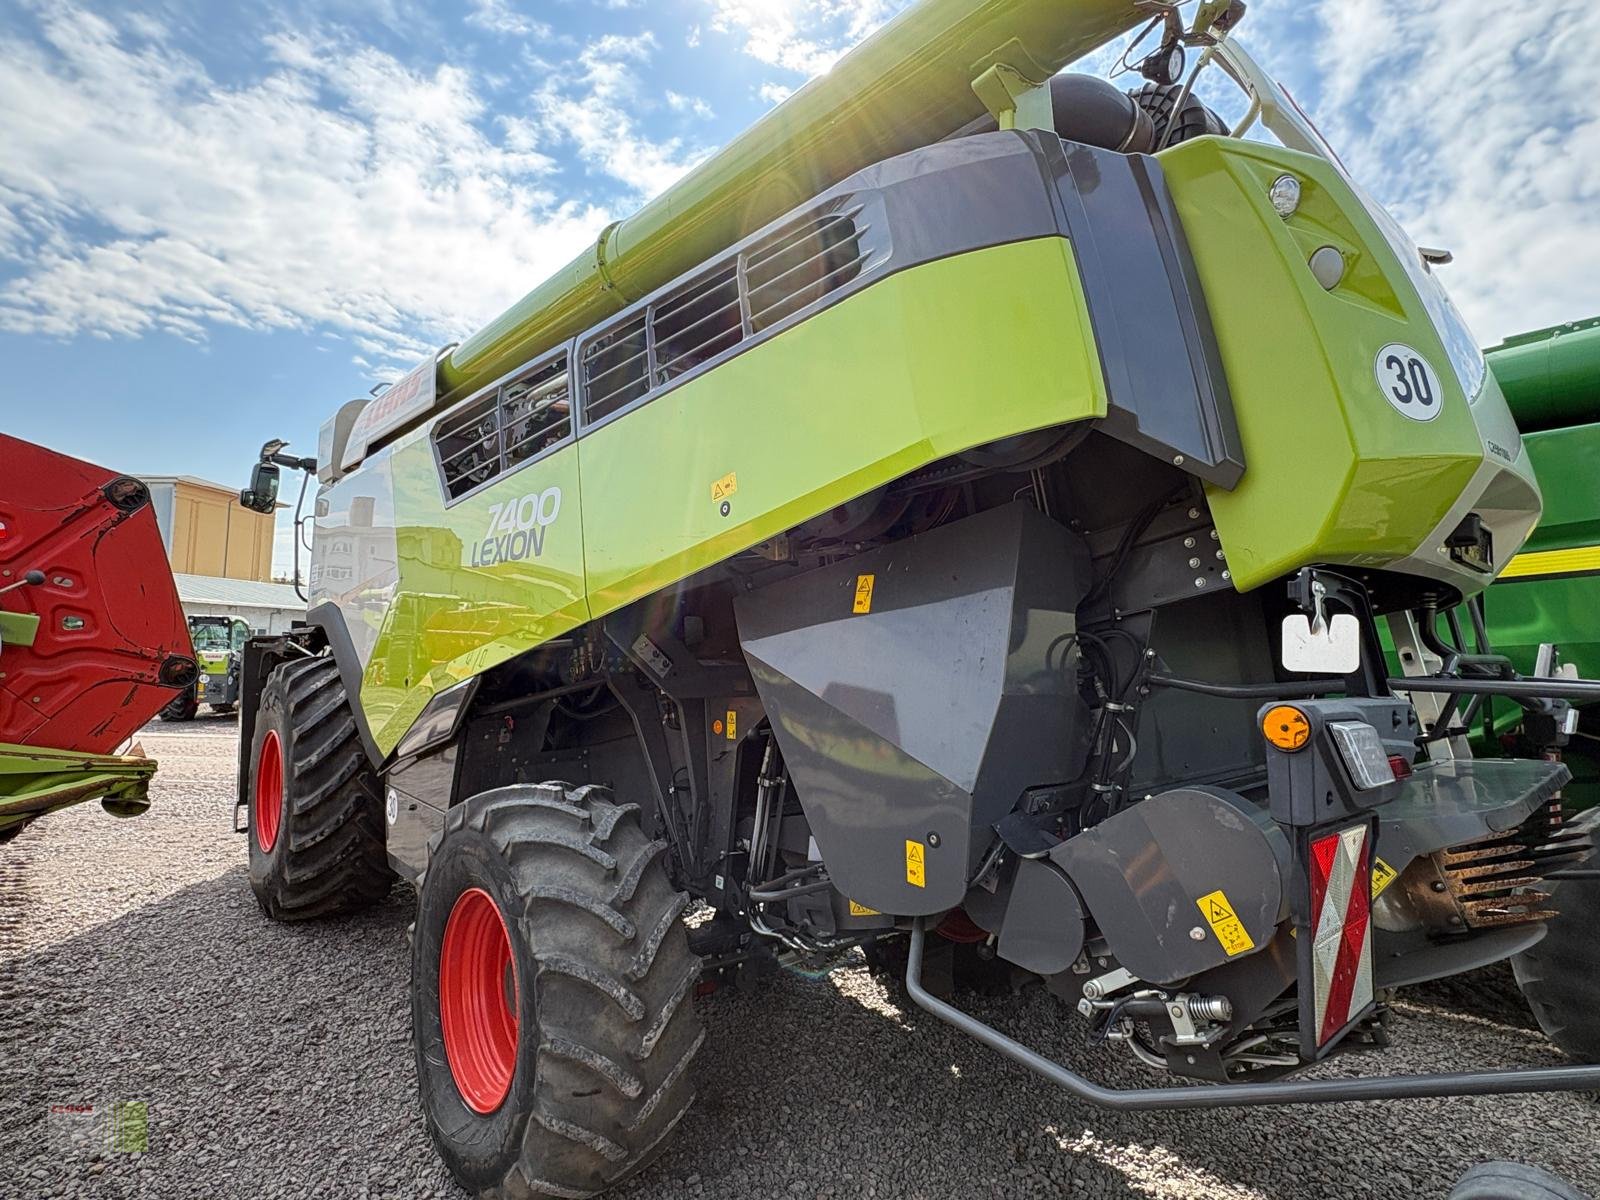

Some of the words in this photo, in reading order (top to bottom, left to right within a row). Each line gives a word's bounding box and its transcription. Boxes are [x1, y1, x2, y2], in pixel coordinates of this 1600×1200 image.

[1386, 355, 1433, 406] 30
[486, 486, 562, 541] 7400
[471, 525, 546, 568] LEXION
